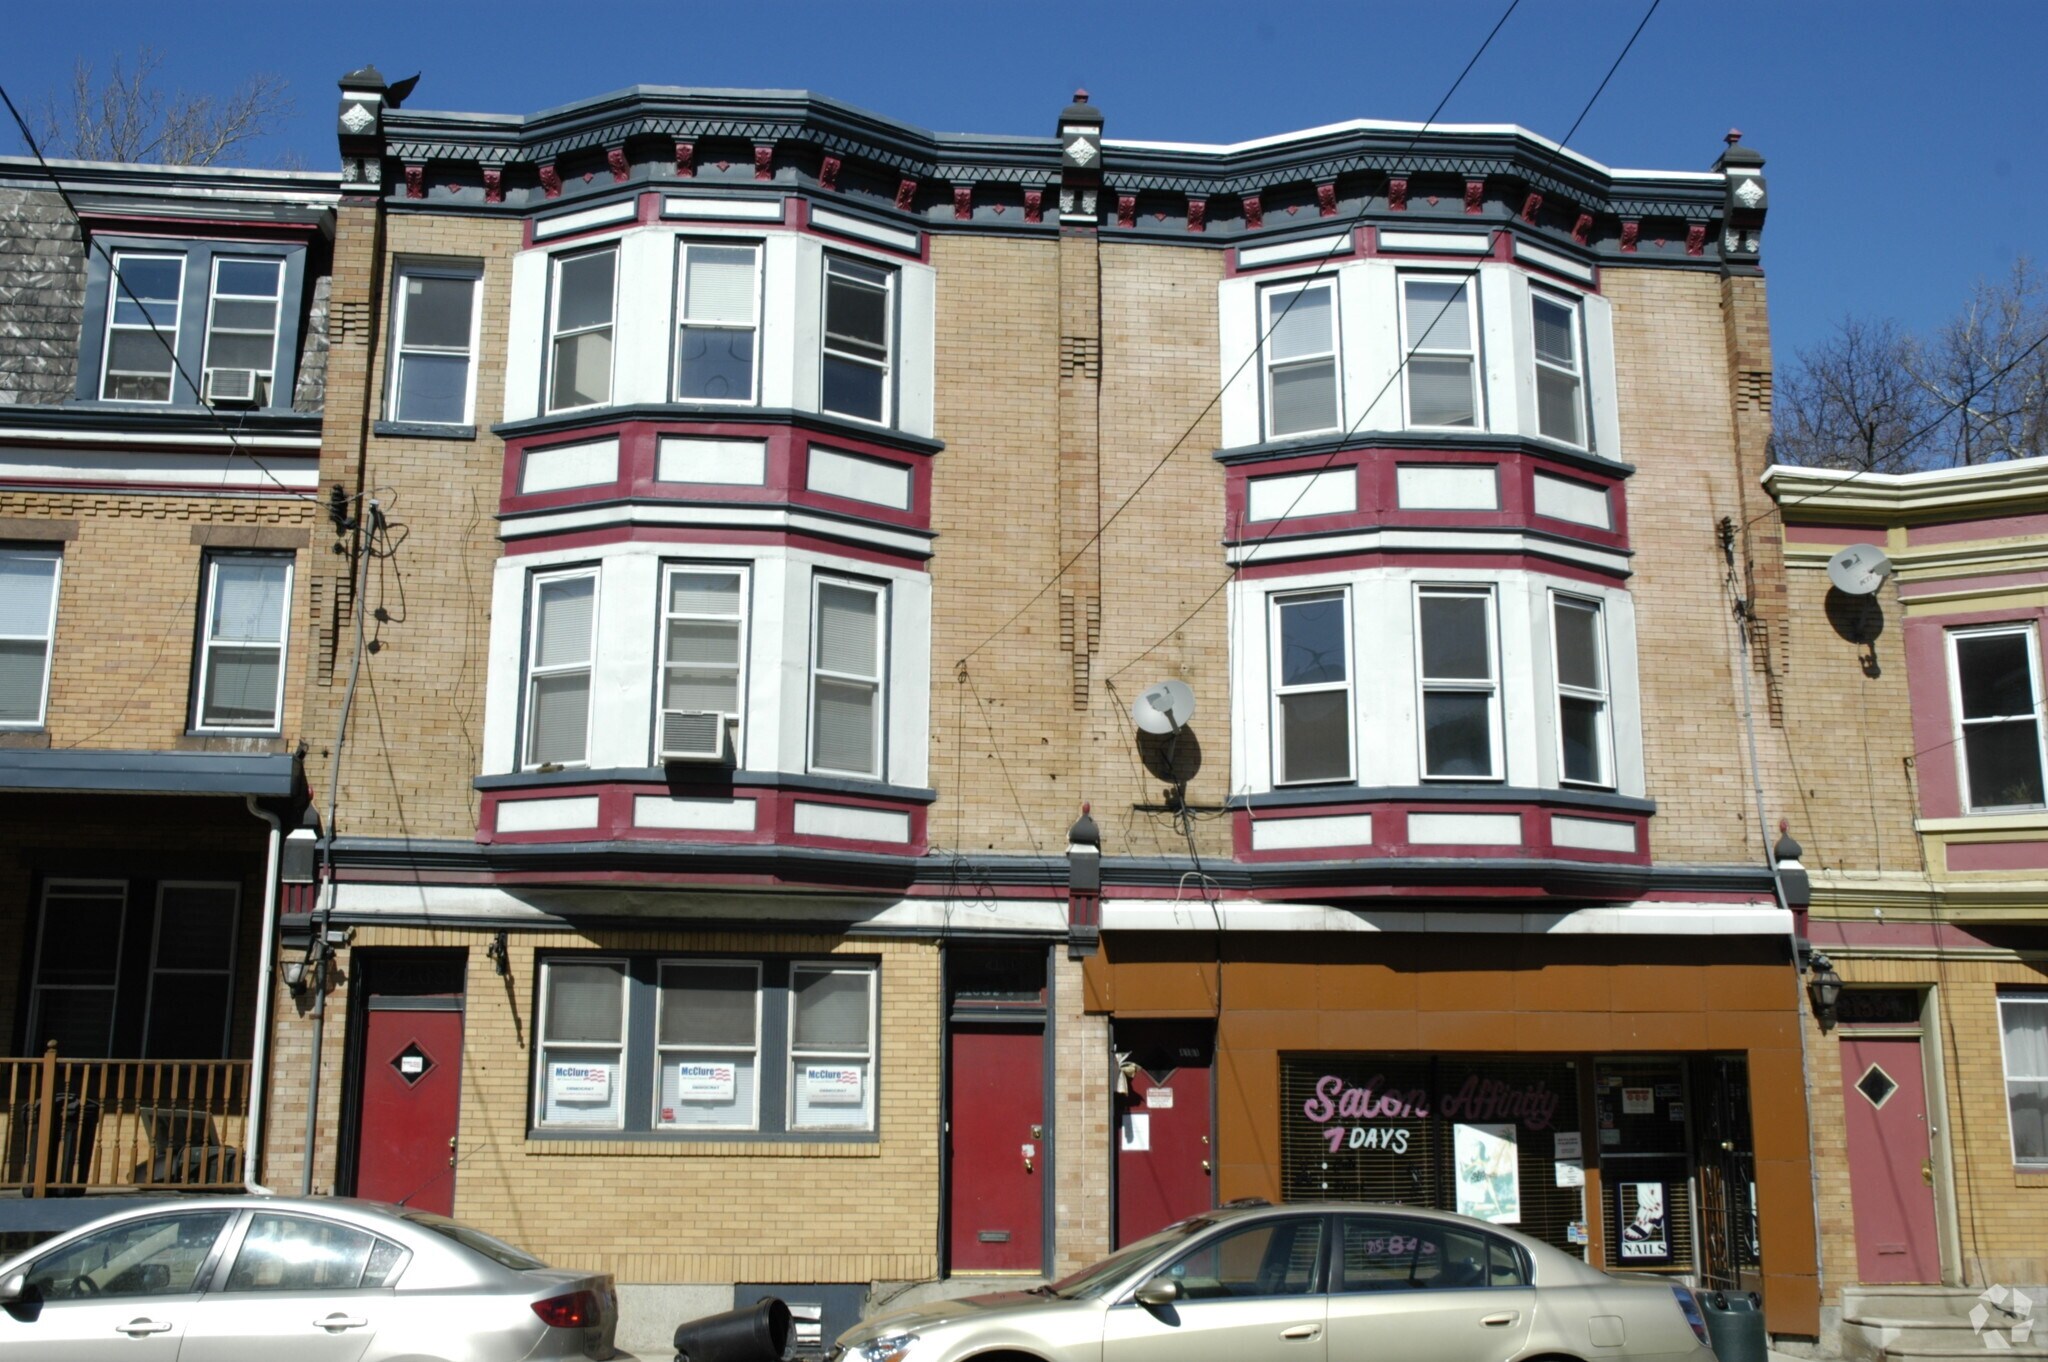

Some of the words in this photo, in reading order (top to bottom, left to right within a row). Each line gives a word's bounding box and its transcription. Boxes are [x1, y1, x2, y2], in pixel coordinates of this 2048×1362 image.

[555, 1067, 589, 1077] McClure
[681, 1067, 714, 1076] McClure
[808, 1070, 841, 1079] McClure
[1303, 1073, 1430, 1123] Salon
[1440, 1074, 1559, 1131] Affinity
[1323, 1126, 1345, 1154] 7
[1348, 1127, 1410, 1155] DAYS
[1624, 1244, 1666, 1255] NAILS
